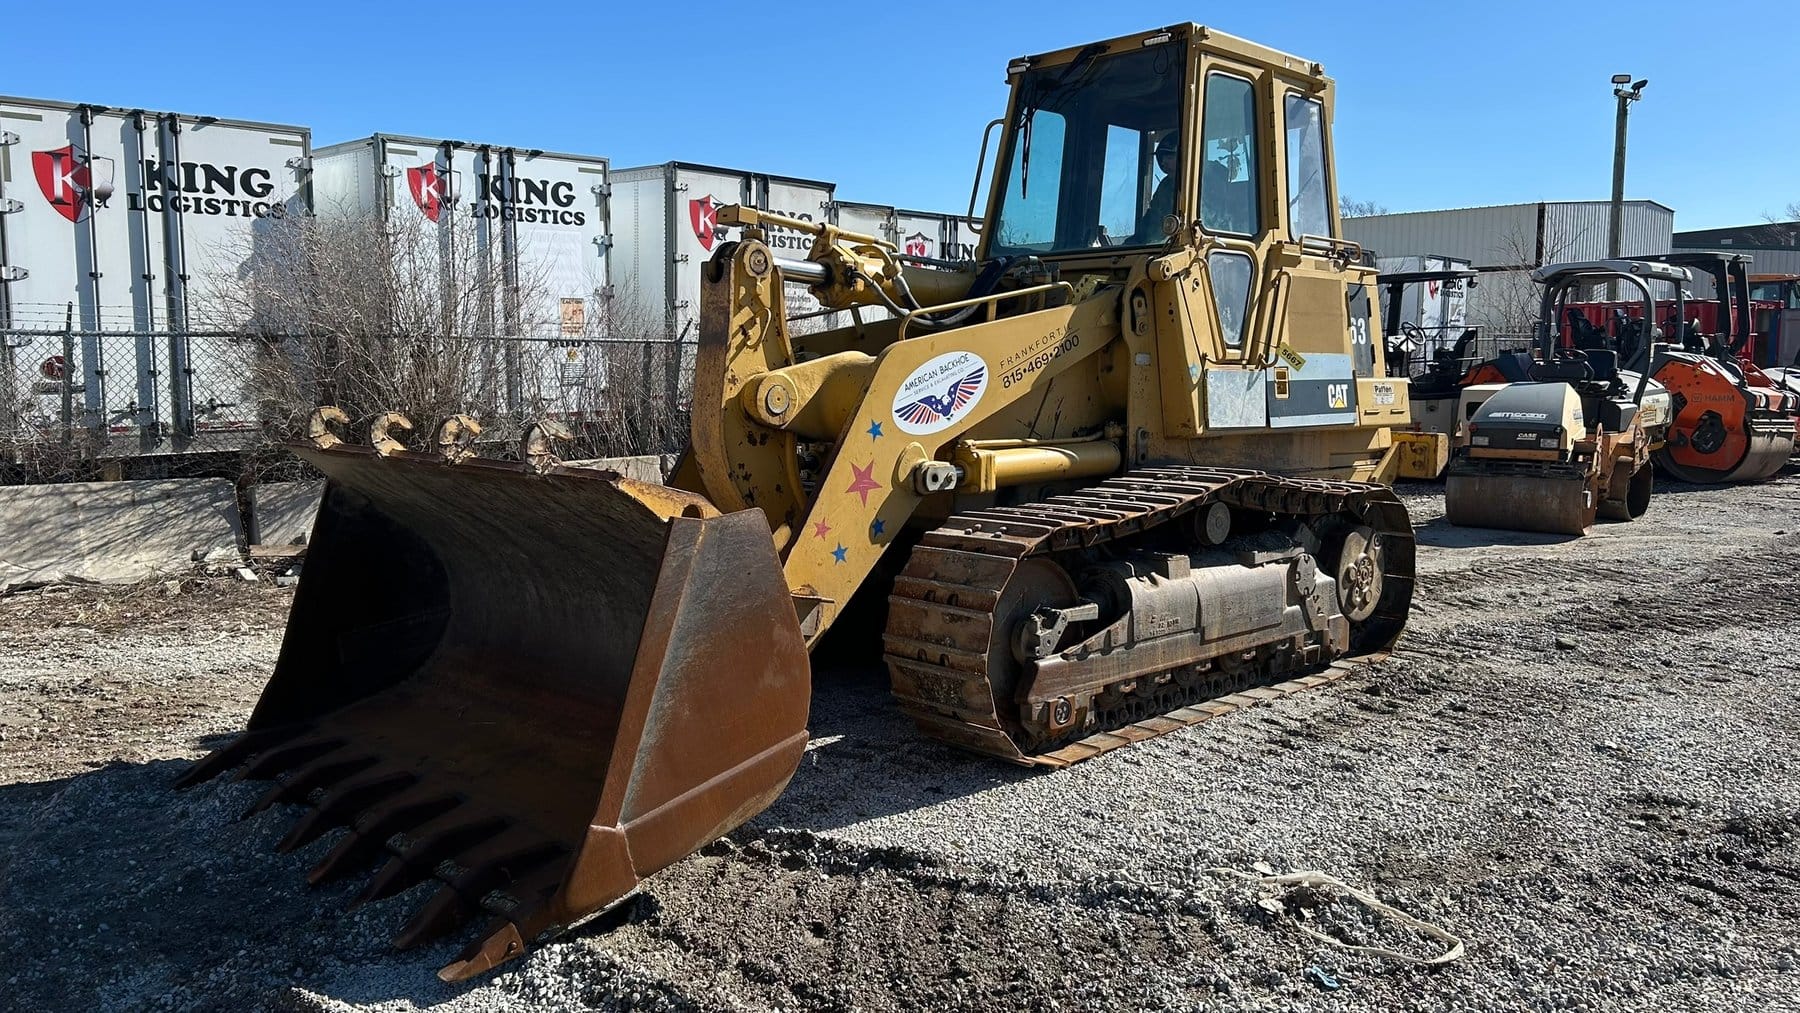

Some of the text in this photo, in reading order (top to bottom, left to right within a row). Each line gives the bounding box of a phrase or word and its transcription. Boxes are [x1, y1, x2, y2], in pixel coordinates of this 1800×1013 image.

[139, 159, 274, 198] KING
[479, 173, 576, 208] KING
[127, 193, 287, 219] LOGISTICS
[470, 203, 586, 226] LOGISTICS
[940, 242, 978, 262] KIN
[1281, 349, 1301, 367] 5667
[904, 353, 970, 392] AMERICAN BACKHOE
[1327, 384, 1349, 409] CAT
